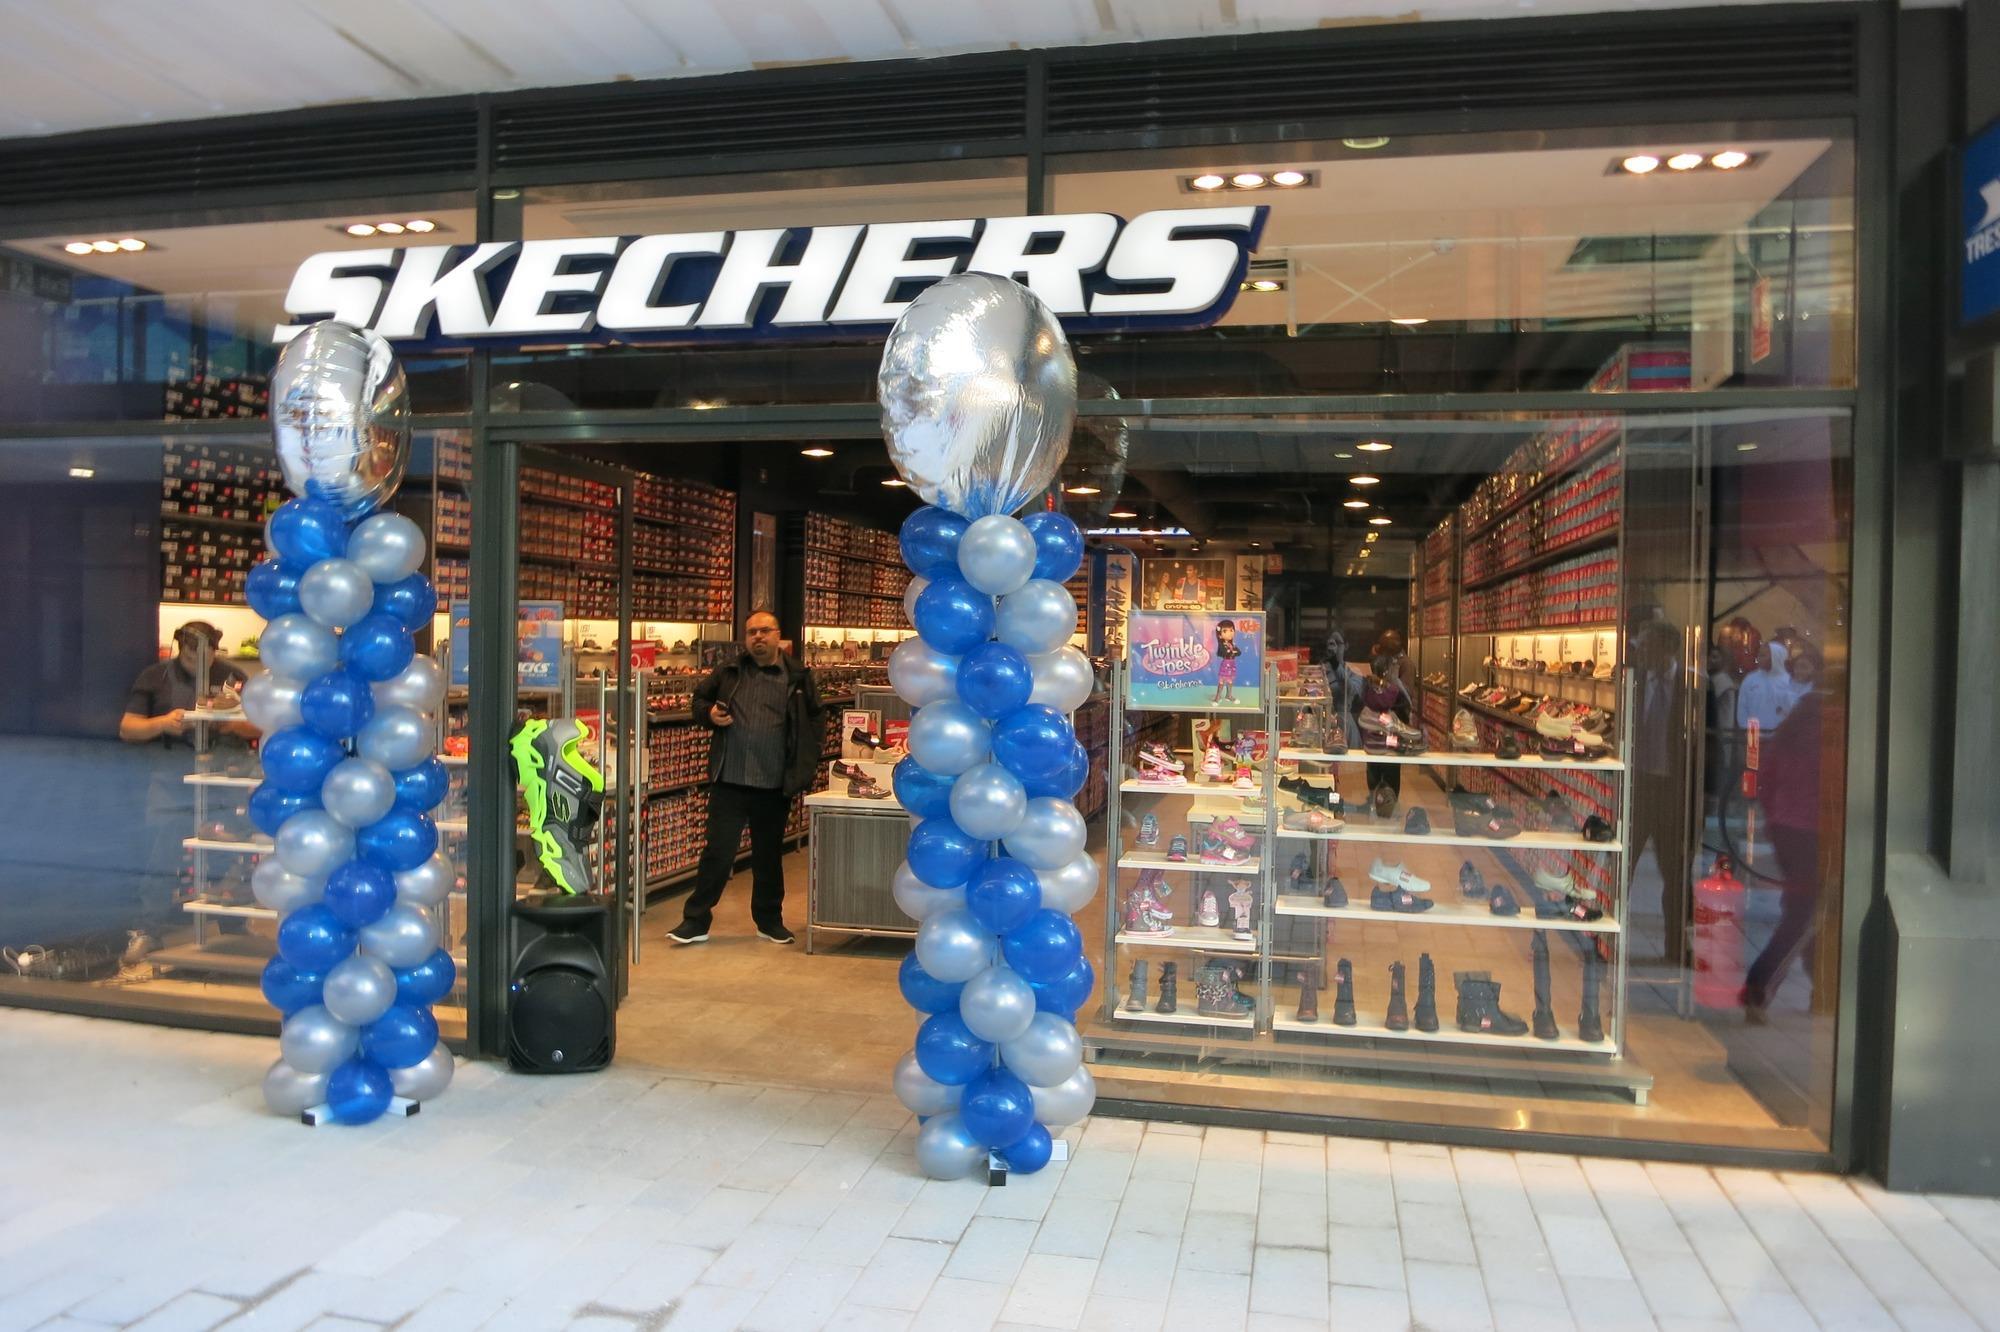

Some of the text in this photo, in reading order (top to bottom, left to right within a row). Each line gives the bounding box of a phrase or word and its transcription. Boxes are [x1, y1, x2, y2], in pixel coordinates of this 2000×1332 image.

[272, 205, 1258, 343] SKECHERS
[1141, 636, 1204, 660] Twinkle
[1157, 659, 1192, 677] toes
